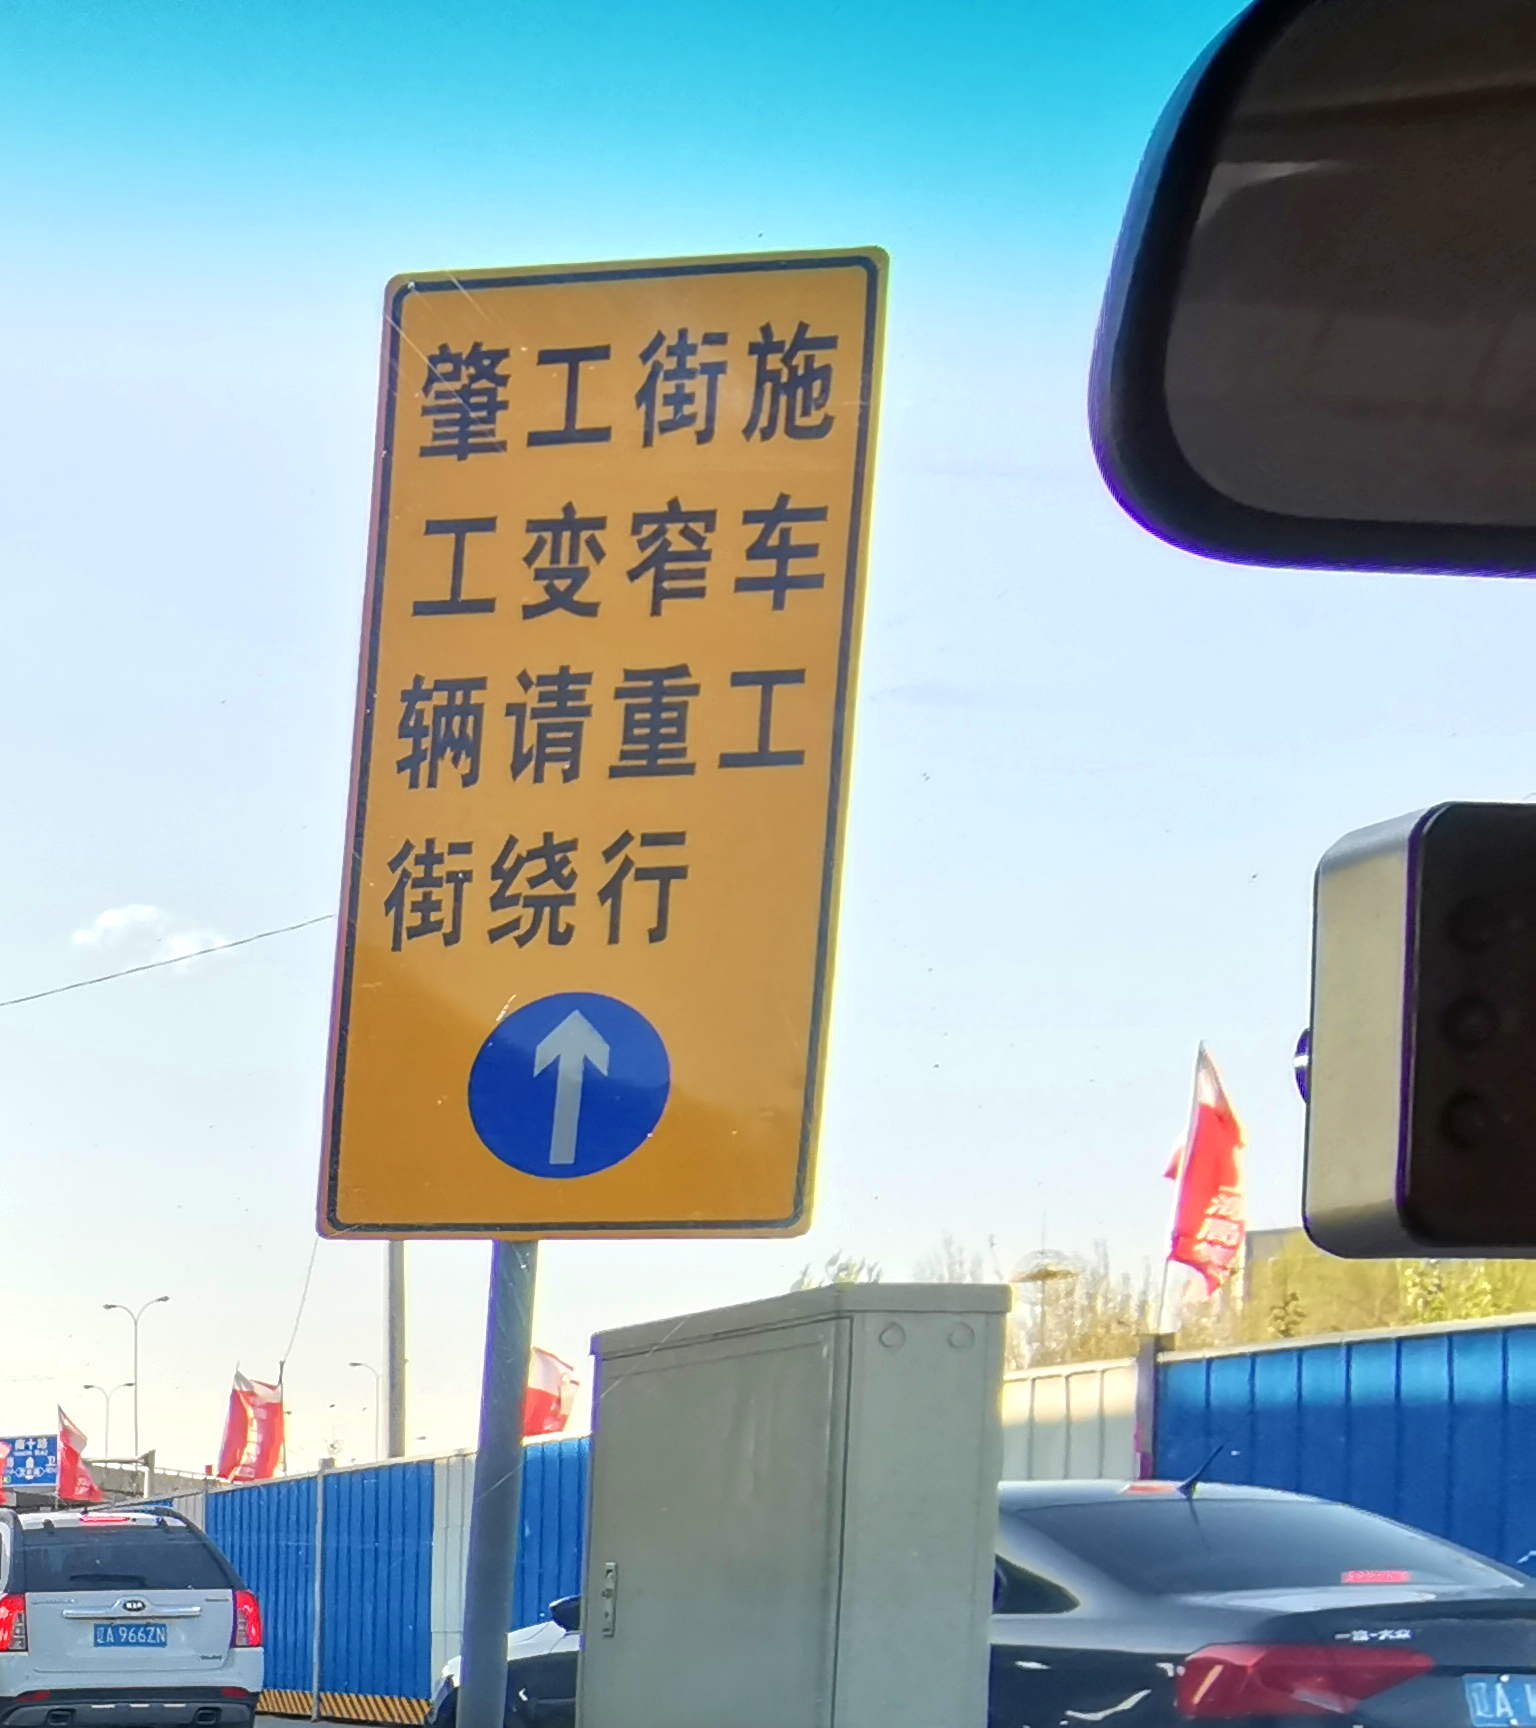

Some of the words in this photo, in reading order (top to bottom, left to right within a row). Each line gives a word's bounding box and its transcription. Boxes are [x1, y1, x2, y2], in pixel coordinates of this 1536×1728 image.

[419, 322, 837, 461] 肇工街施
[412, 493, 827, 620] 工变窄车
[395, 664, 806, 789] 辆请重工
[383, 831, 688, 952] 街绕行
